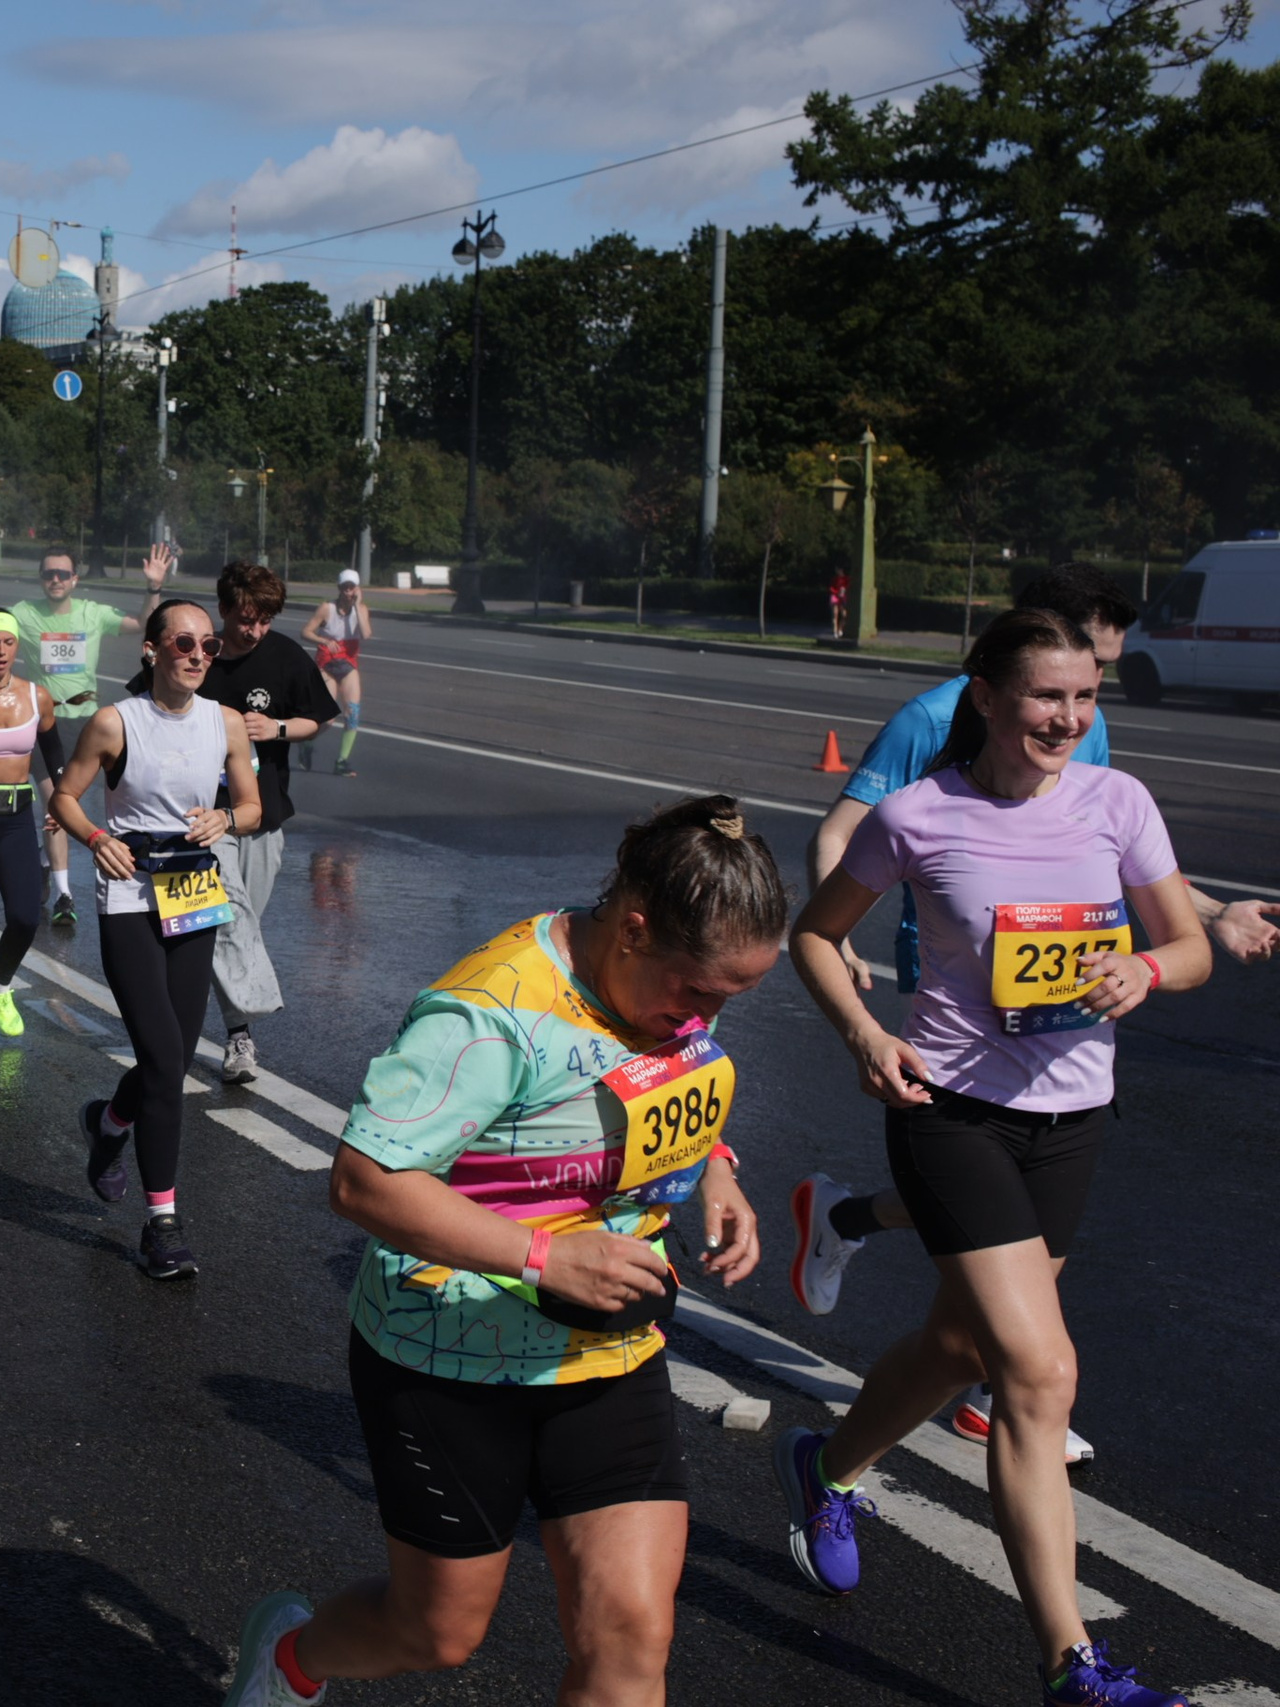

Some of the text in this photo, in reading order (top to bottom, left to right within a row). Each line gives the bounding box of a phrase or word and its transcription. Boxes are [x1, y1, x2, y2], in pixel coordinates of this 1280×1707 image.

[51, 644, 76, 657] 386
[166, 870, 218, 900] 4024
[185, 895, 209, 908] ЛИДИЯ
[1015, 906, 1041, 914] ПОЛУ
[1082, 911, 1103, 923] 21,1
[1016, 914, 1062, 923] МАРАФОН
[1046, 984, 1078, 997] АННА
[679, 1047, 697, 1063] 21,1
[621, 1059, 646, 1077] ПОЛУ
[628, 1061, 669, 1085] МАРАФОН
[642, 1077, 721, 1157] 3986
[644, 1133, 712, 1175] АЛЕКСАНДРА
